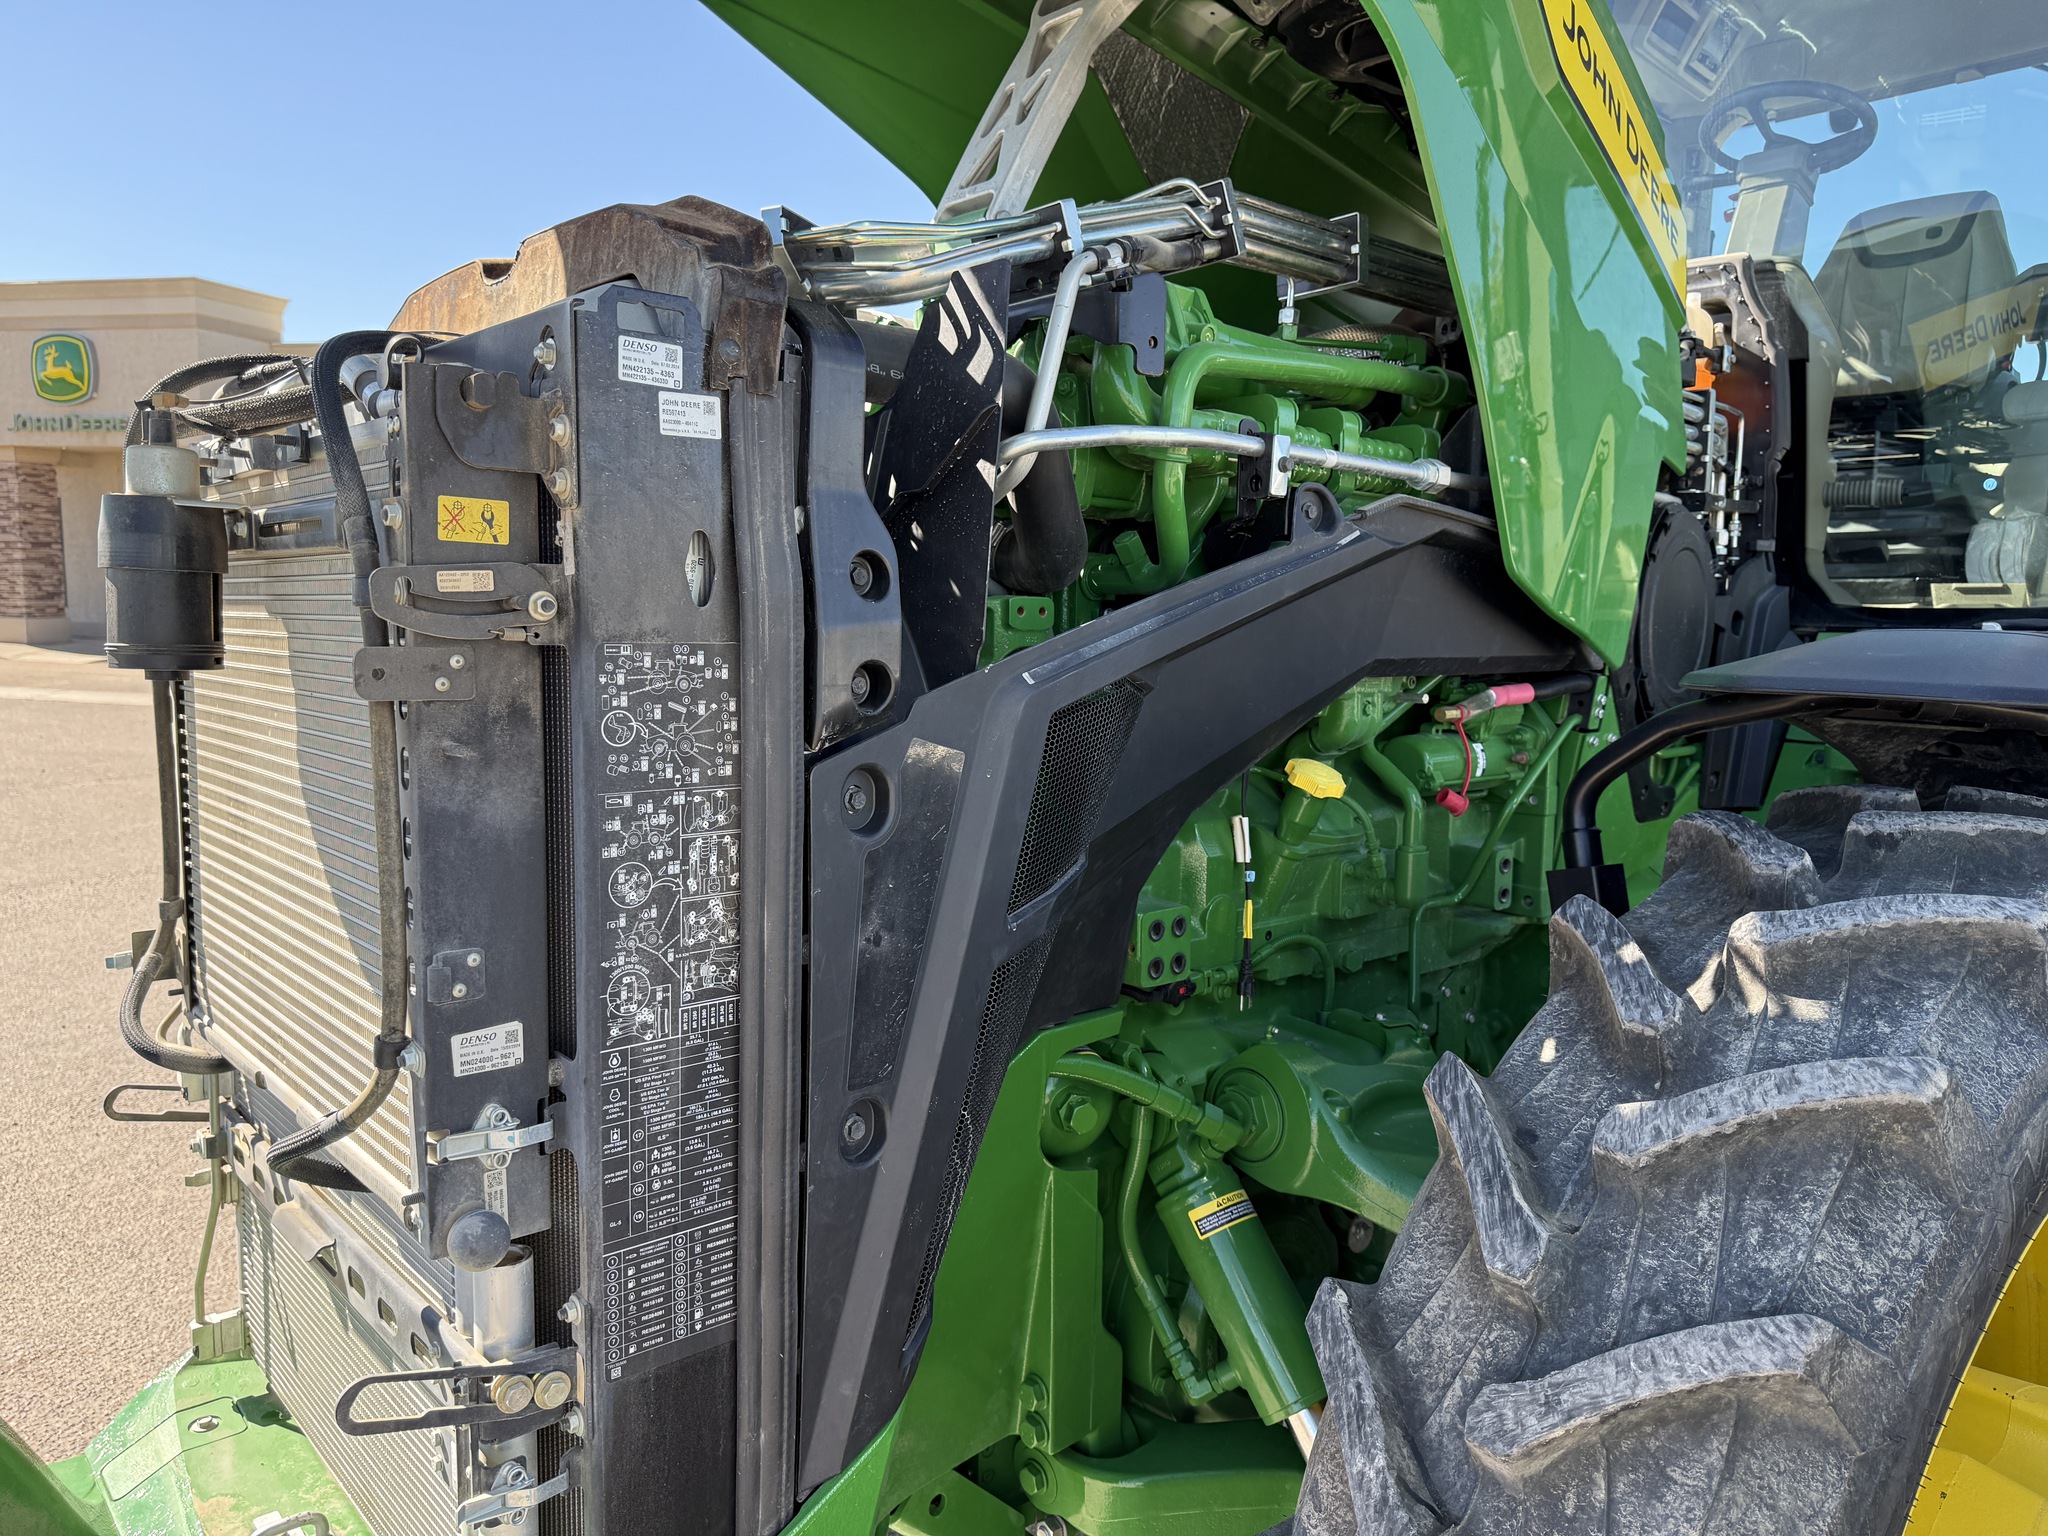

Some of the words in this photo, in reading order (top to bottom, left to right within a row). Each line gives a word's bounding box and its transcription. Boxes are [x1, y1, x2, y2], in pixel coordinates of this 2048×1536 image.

[1563, 0, 1621, 136] JOHN
[1626, 110, 1679, 259] DEERE
[622, 339, 658, 353] DENSO
[662, 398, 679, 407] JOHN
[680, 400, 701, 410] DEERE
[8, 414, 63, 432] JOHN
[63, 414, 128, 432] DEERE
[460, 1032, 497, 1046] DENSO
[1221, 1192, 1245, 1205] CAUTION
[609, 1220, 622, 1228] GL-5
